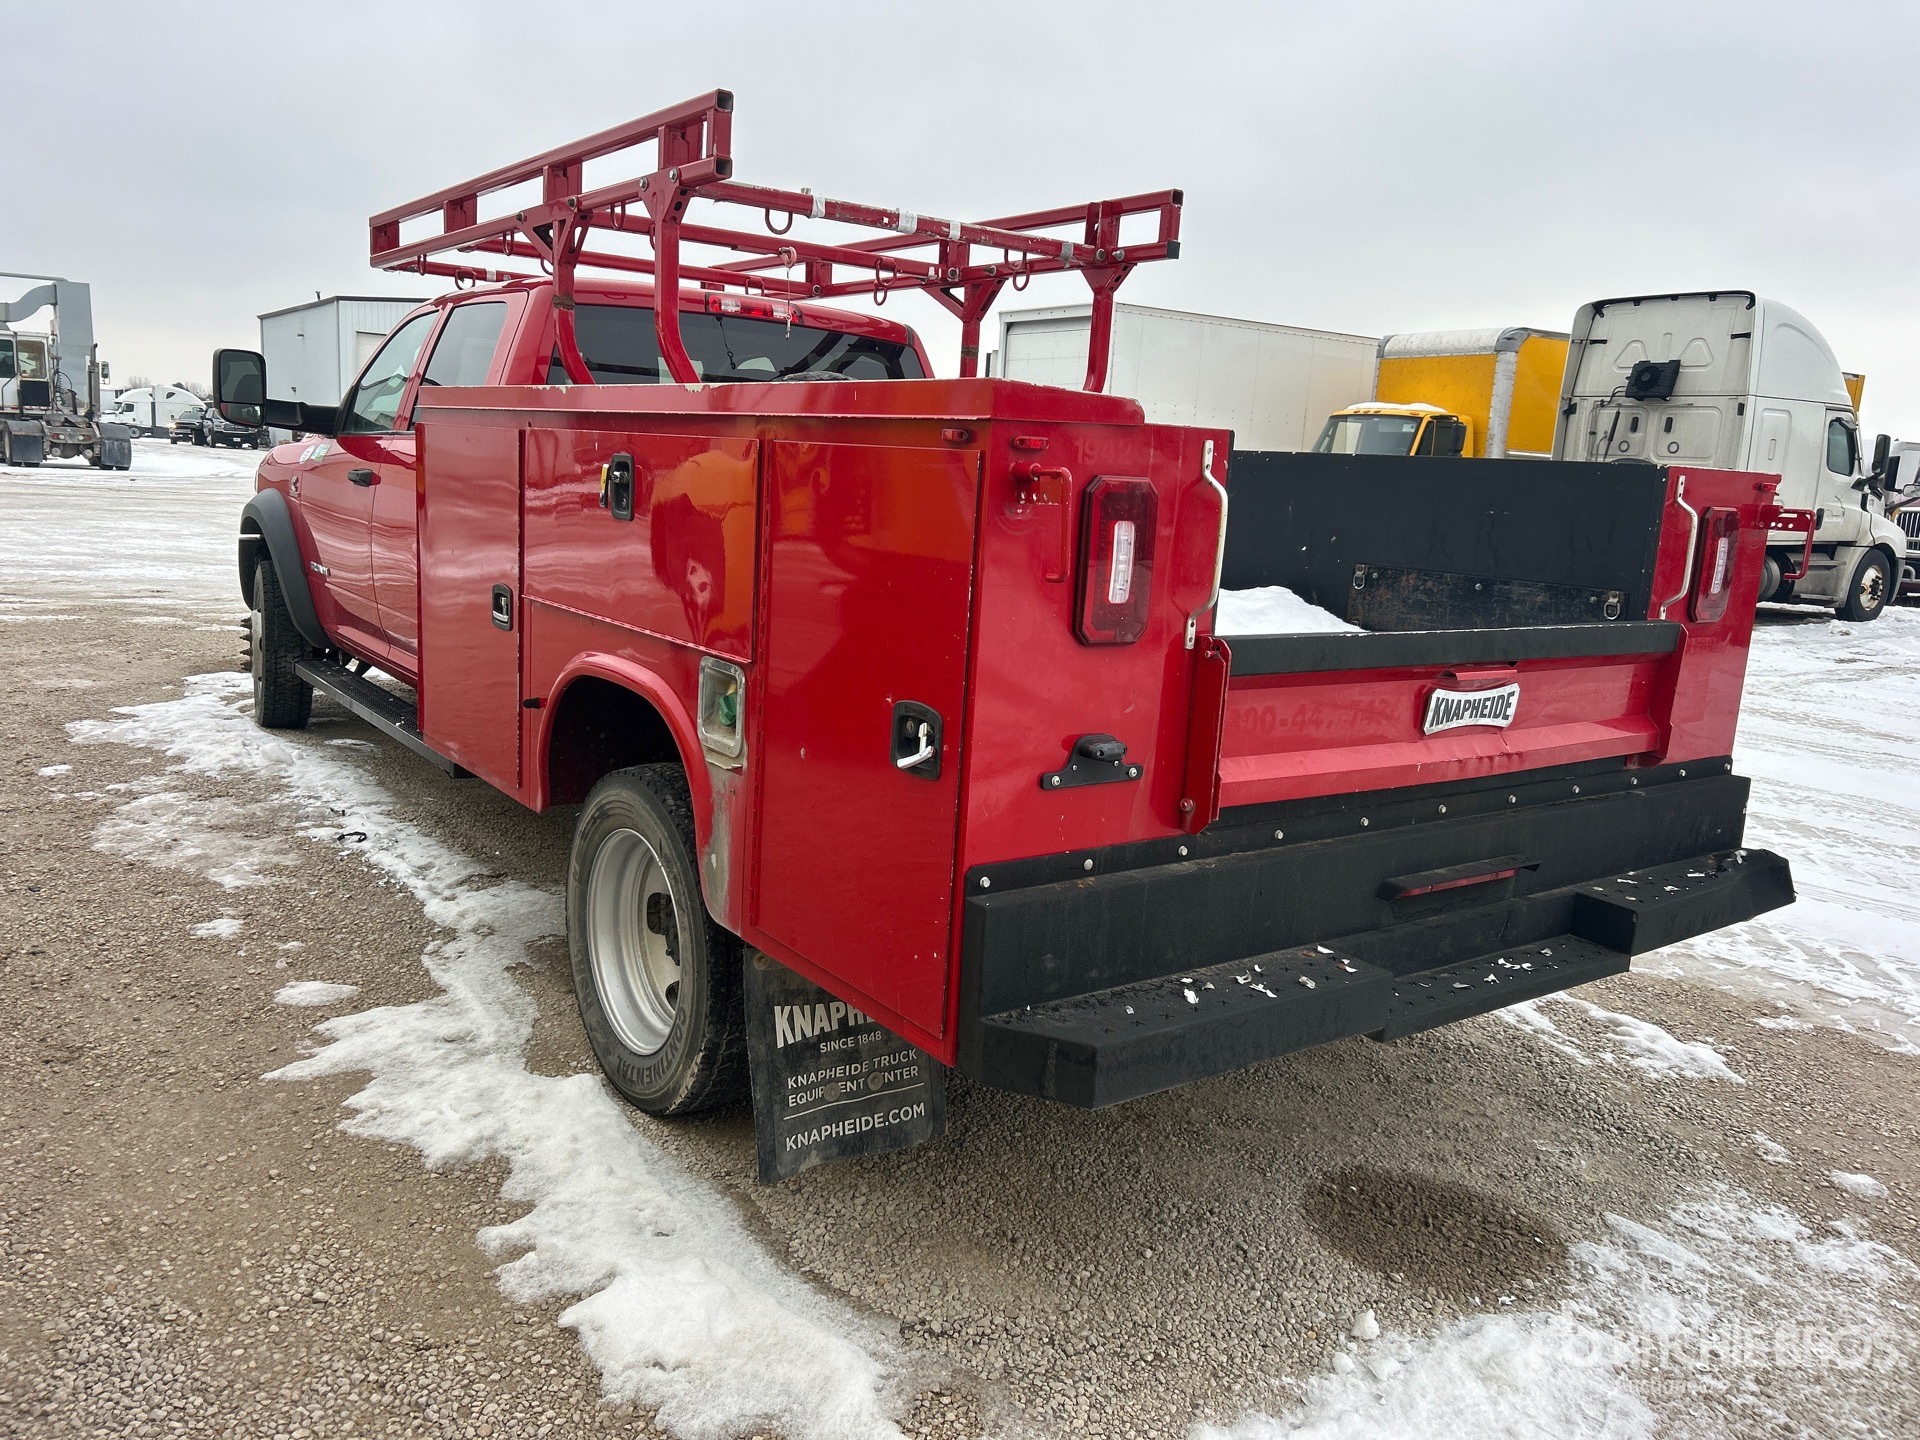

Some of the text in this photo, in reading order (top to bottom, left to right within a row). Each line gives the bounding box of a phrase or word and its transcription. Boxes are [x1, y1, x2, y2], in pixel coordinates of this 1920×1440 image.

[1429, 691, 1515, 728] KNAPHEIDE
[820, 1030, 882, 1053] SINCE 1848
[787, 1048, 917, 1090] KNAPHEIDE TRUCK
[788, 1078, 865, 1107] EQUIPENT
[785, 1102, 925, 1152] KNAPHEIDE.COM
